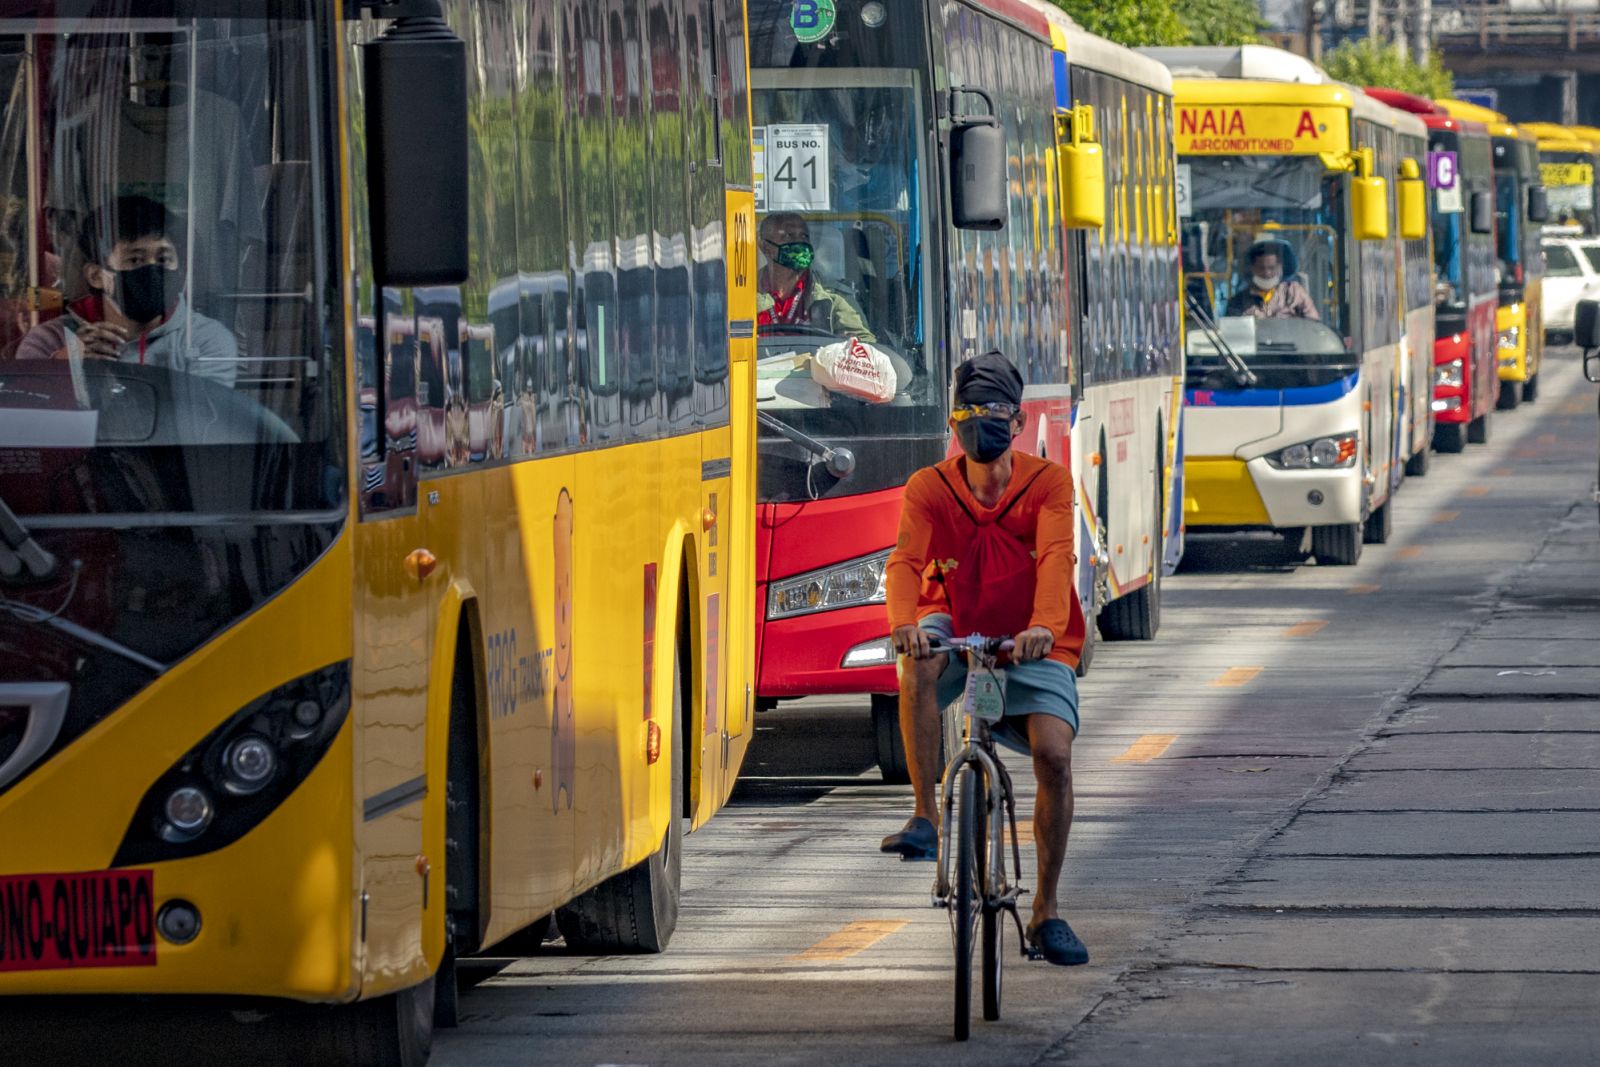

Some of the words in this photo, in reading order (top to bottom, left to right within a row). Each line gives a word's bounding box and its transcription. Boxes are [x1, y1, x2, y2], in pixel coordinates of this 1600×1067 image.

[794, 0, 818, 28] B
[1180, 108, 1246, 136] NAIA
[1295, 110, 1318, 139] A
[776, 140, 799, 149] BUS
[801, 140, 821, 149] NO.
[1189, 138, 1294, 152] AIRCONDITIONED
[773, 155, 817, 190] 41
[734, 212, 748, 288] 820
